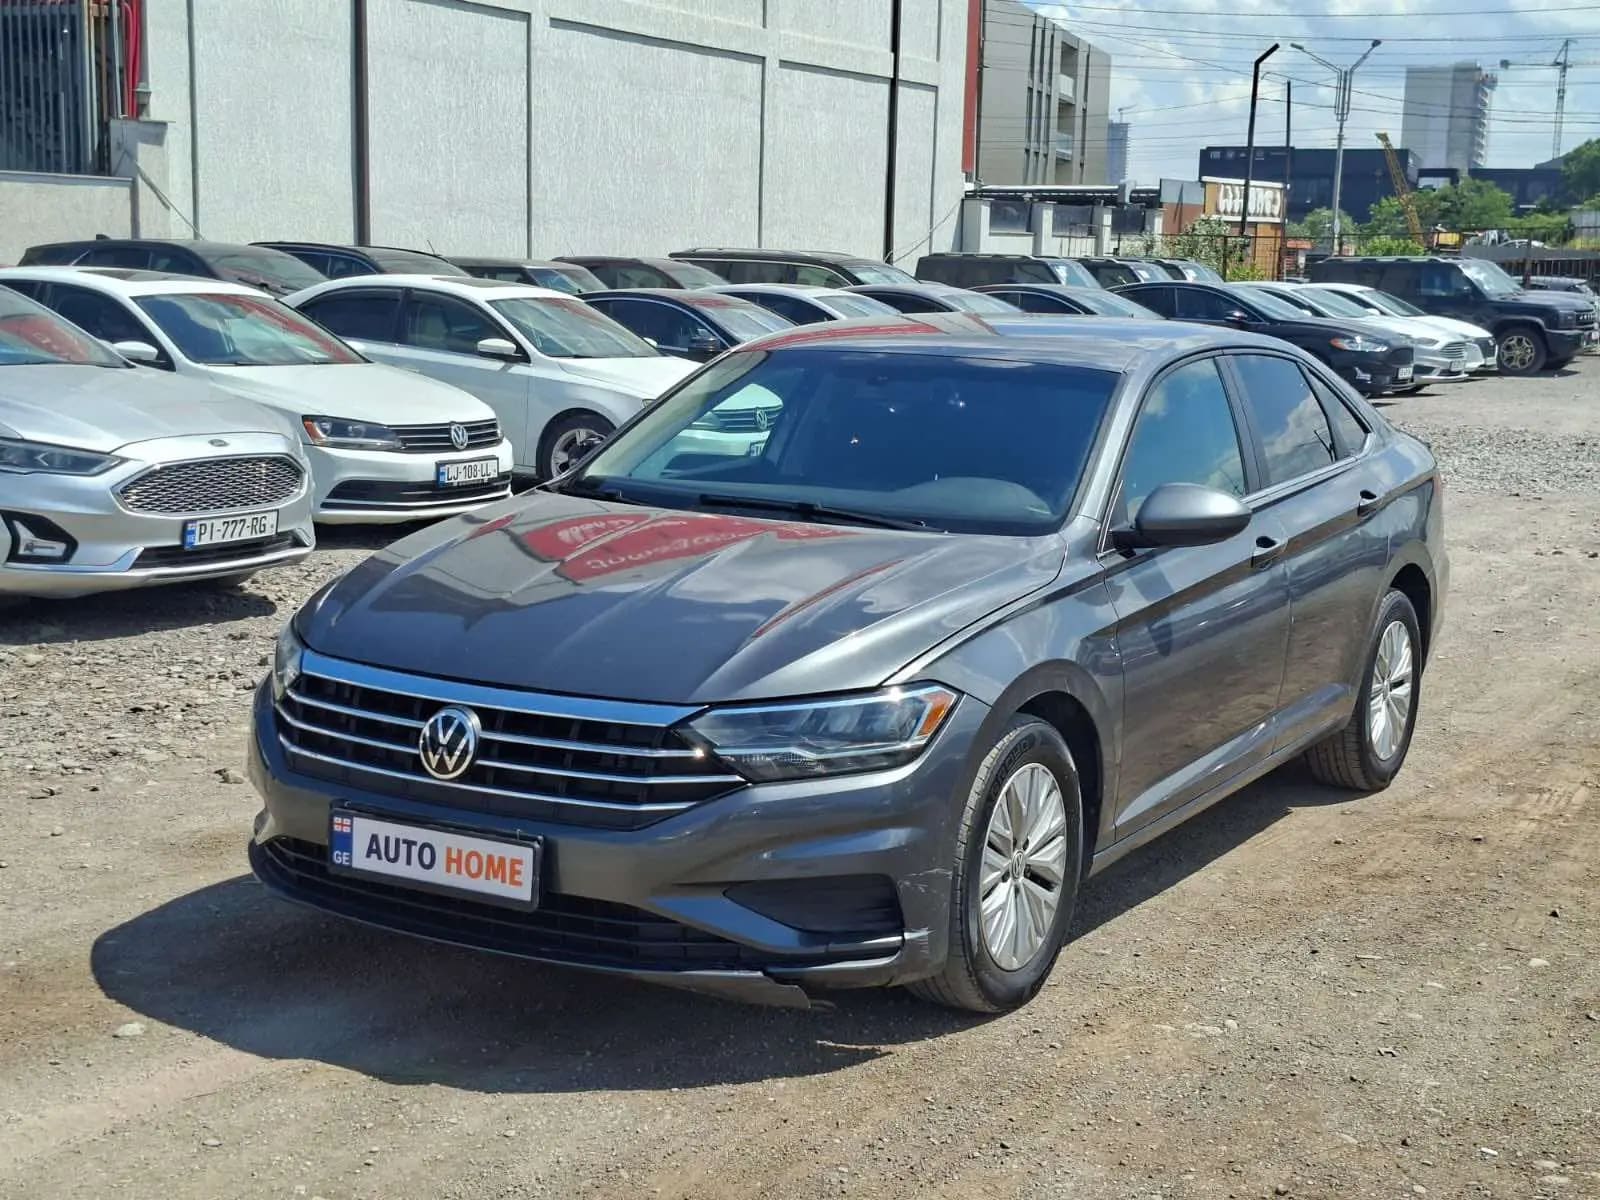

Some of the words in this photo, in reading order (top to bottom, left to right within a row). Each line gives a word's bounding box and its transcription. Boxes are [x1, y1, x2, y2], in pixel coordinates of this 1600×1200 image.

[446, 463, 492, 481] LJ-108-LL
[198, 515, 267, 542] PI-777-RG
[420, 708, 475, 778] VW
[333, 850, 350, 865] GE
[366, 833, 437, 870] AUTO
[445, 846, 524, 887] HOME
